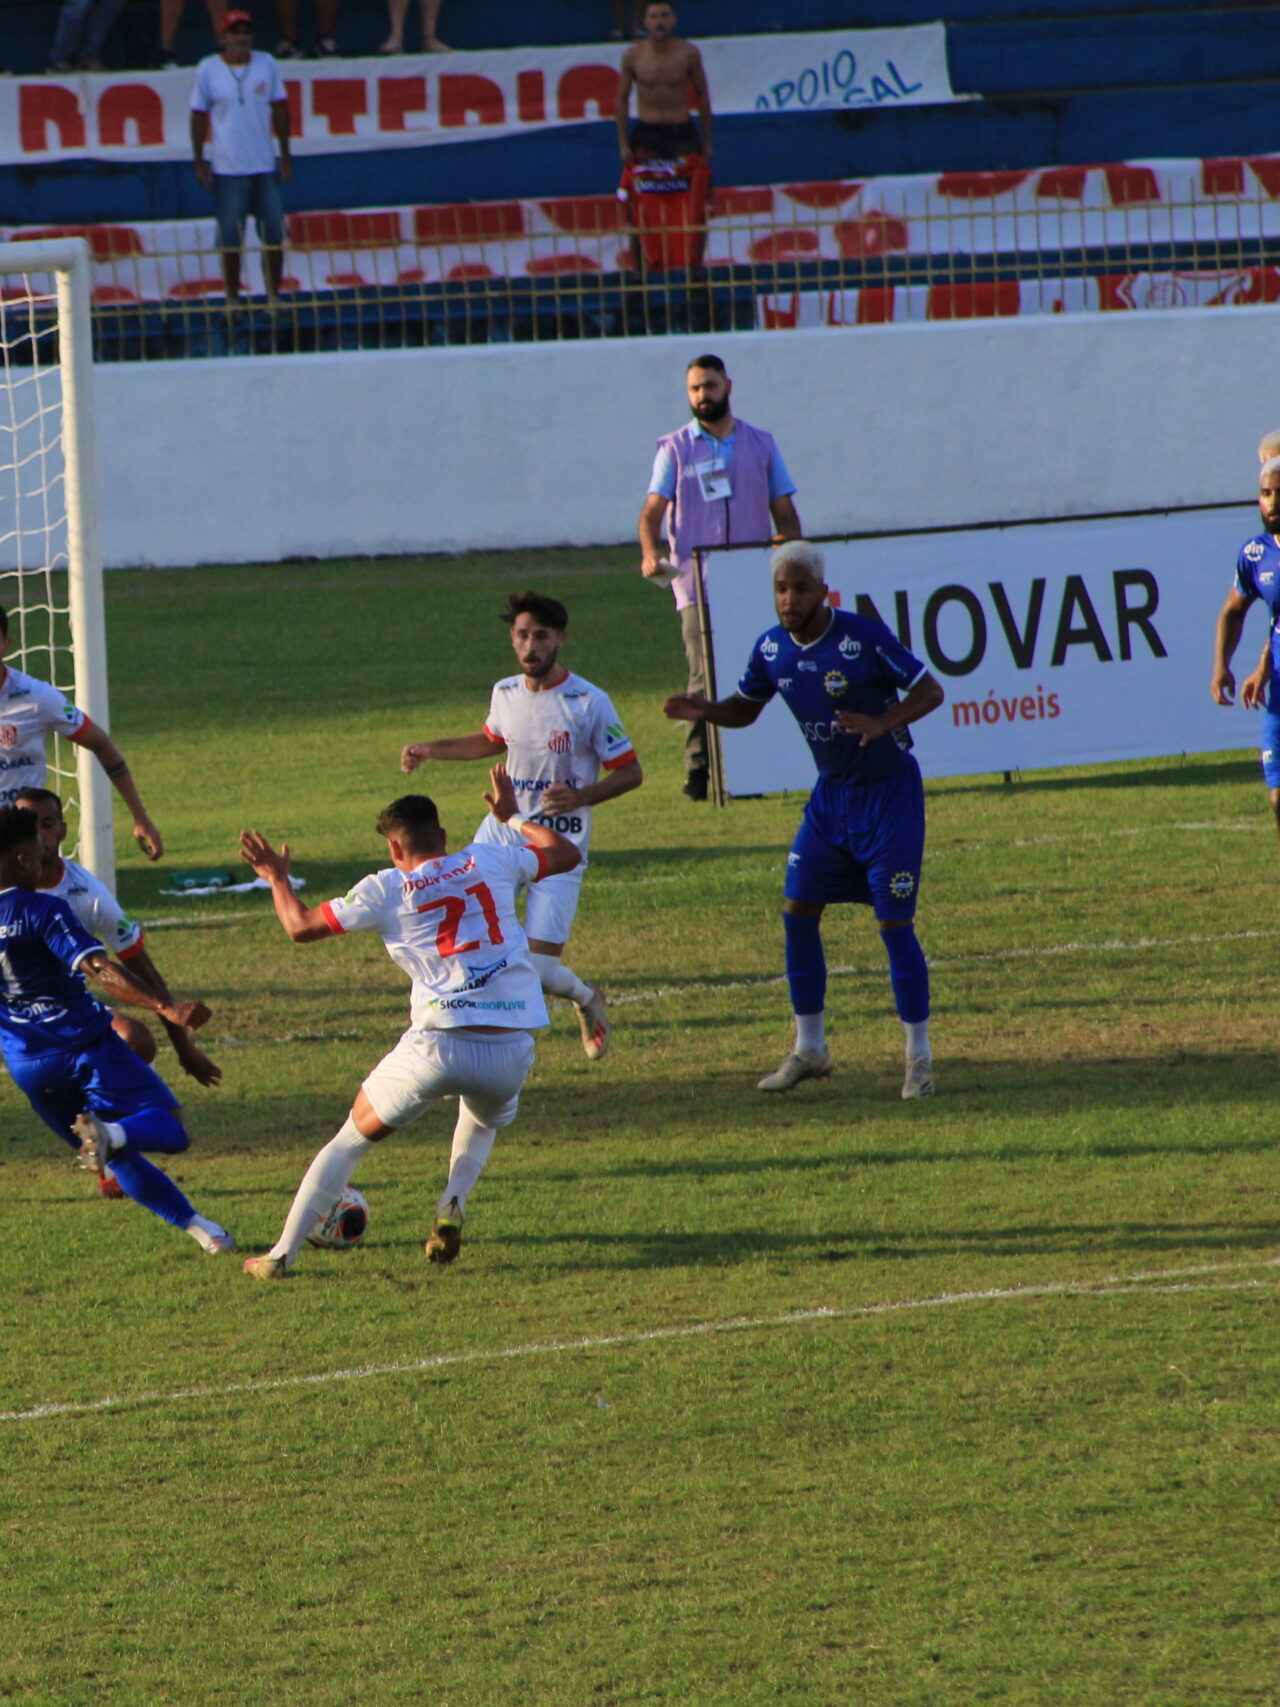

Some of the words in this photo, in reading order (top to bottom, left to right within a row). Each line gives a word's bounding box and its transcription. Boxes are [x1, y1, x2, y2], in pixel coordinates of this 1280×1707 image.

[827, 568, 1169, 677] NOVAR
[952, 685, 1061, 728] móveis
[416, 880, 505, 959] 21
